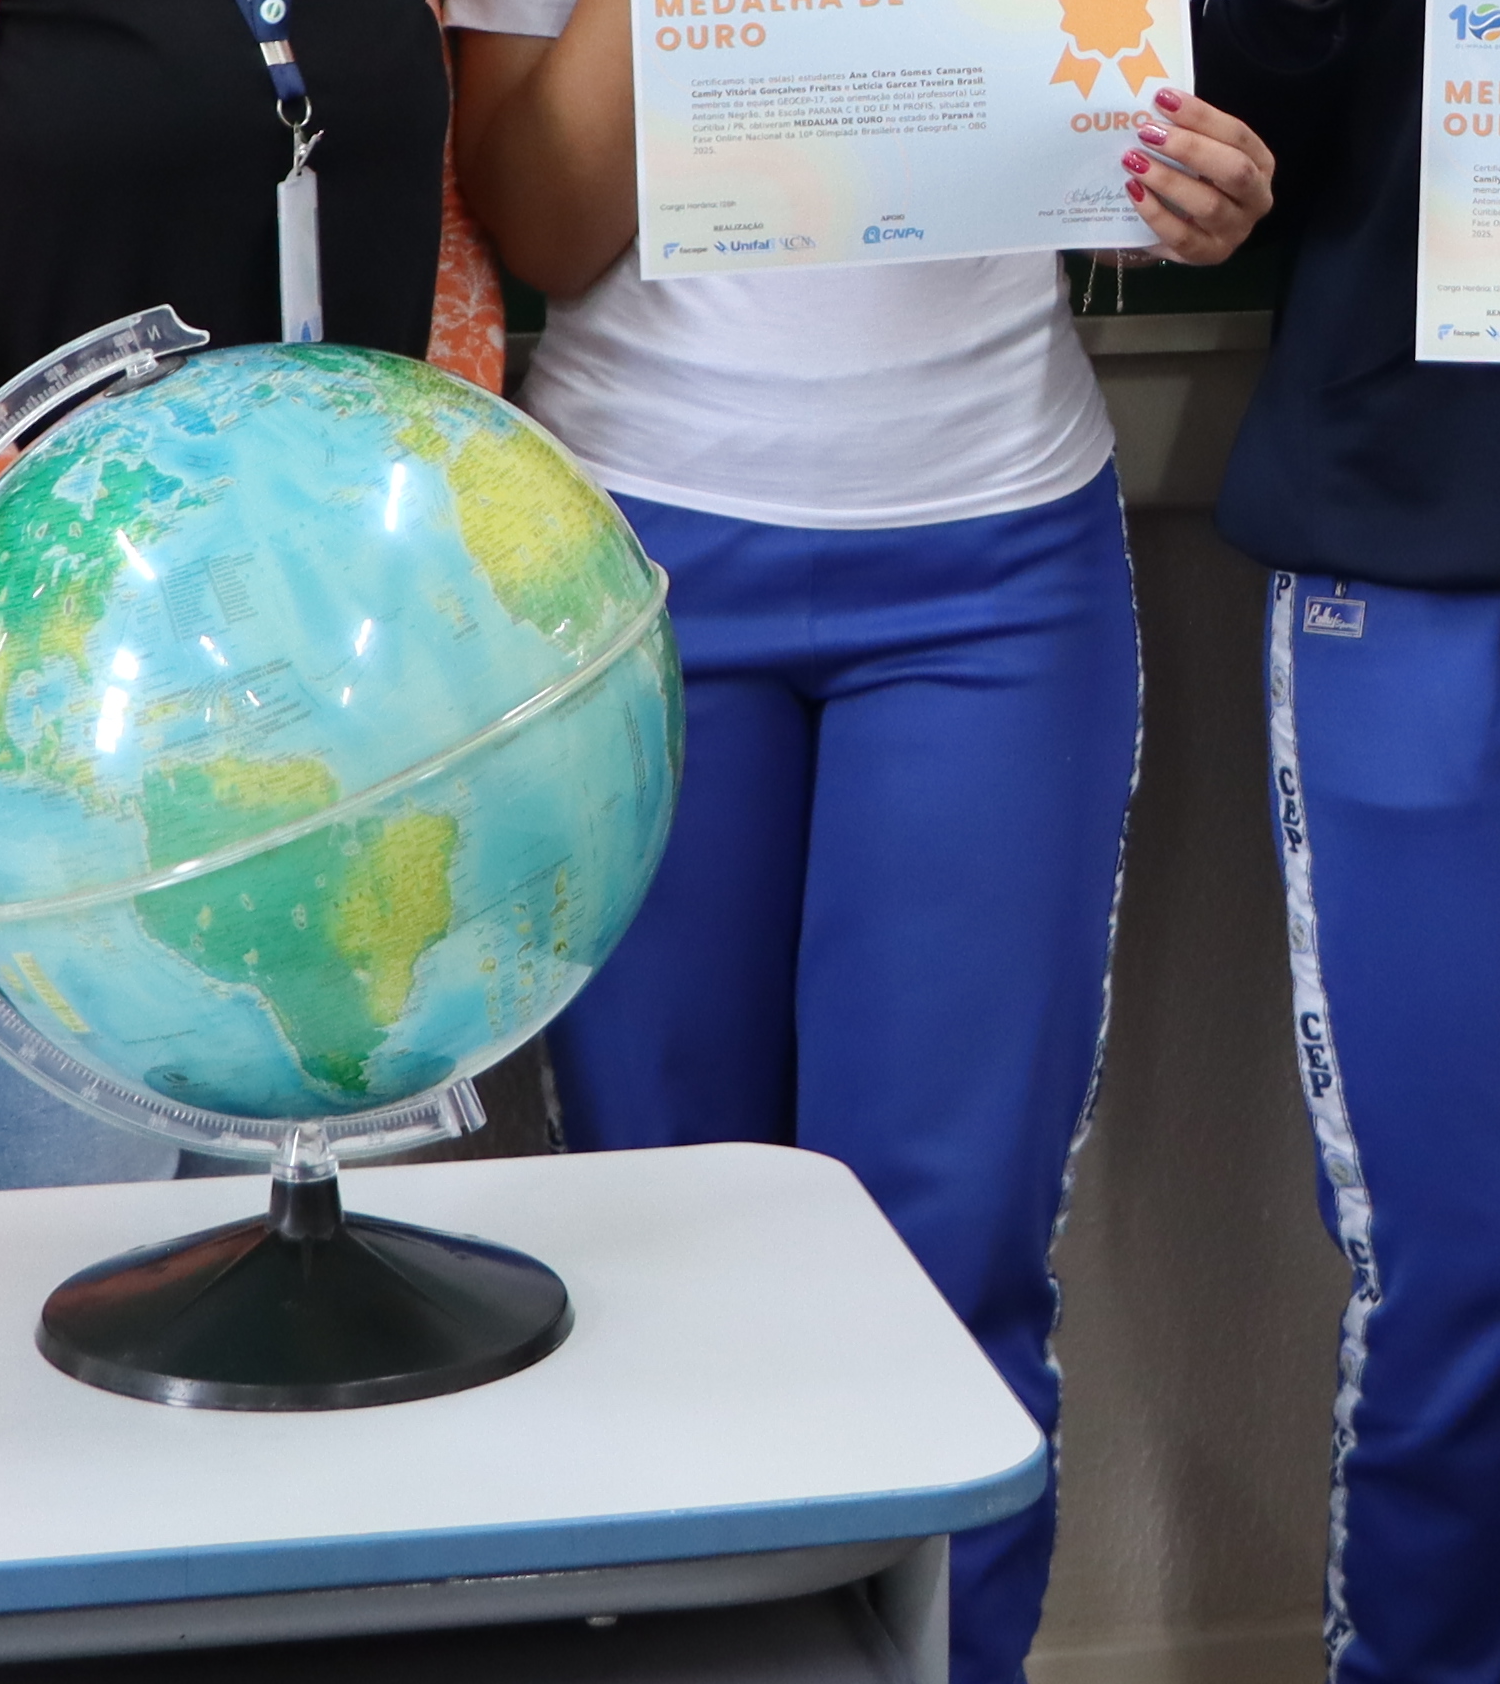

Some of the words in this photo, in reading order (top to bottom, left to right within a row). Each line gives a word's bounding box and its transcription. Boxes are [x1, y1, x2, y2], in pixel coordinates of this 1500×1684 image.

[655, 21, 766, 52] OURO
[848, 70, 867, 79] Ana
[871, 69, 896, 78] Clara
[900, 67, 932, 76] Gomes
[935, 64, 984, 76] Camargos,
[691, 89, 722, 100] Camily
[725, 87, 756, 96] Vitória
[759, 84, 806, 96] Gonçalves
[809, 83, 841, 92] Freitas
[852, 81, 882, 90] Letícia
[886, 79, 916, 88] Garcez
[919, 77, 954, 87] Taveira
[956, 75, 984, 86] Brasil,
[792, 117, 839, 127] MEDALHA
[840, 116, 853, 125] DE
[856, 115, 883, 124] OURO
[941, 110, 974, 120] Paraná
[881, 226, 924, 242] CNPq
[1278, 765, 1303, 854] CEP
[1300, 1012, 1333, 1099] CEP
